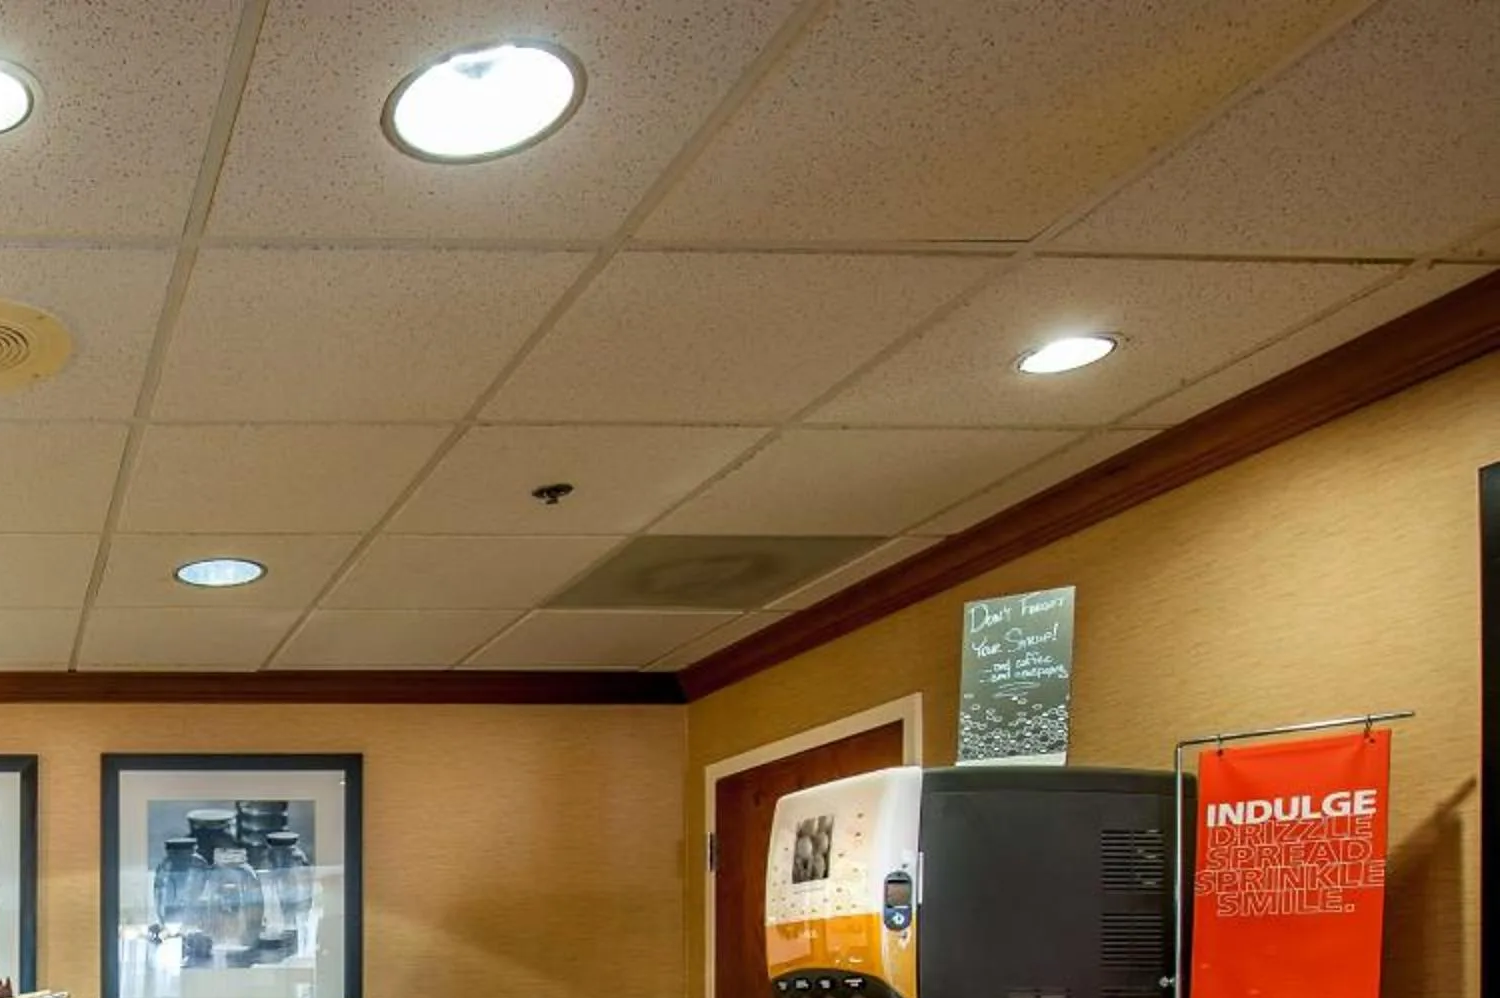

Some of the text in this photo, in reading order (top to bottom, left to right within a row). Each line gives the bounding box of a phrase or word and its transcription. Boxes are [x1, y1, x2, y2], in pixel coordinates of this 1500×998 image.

[1206, 789, 1377, 827] INDULGE
[1208, 814, 1373, 848] DRIZZLE
[1207, 838, 1374, 872] SPREAD
[1194, 860, 1385, 896] SPRINKLE
[1216, 889, 1355, 917] SMILE.
